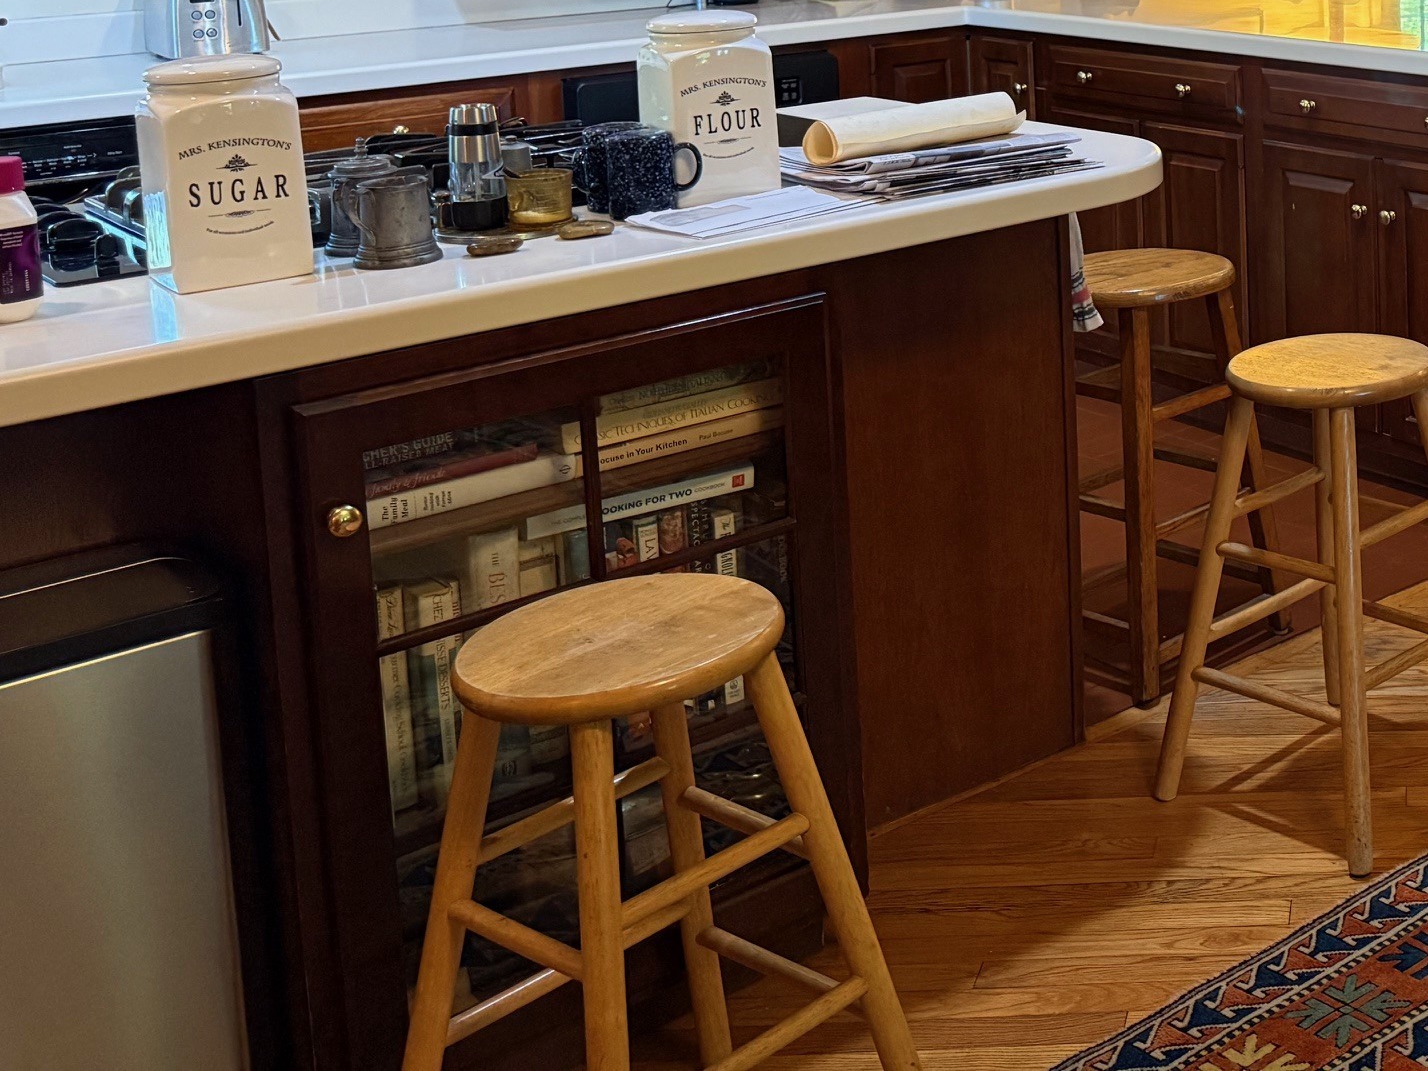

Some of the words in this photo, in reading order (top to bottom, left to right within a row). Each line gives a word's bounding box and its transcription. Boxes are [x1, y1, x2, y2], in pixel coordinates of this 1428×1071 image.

[680, 84, 702, 98] MRS.
[702, 77, 767, 89] KENSINGTON'S
[693, 107, 762, 136] FLOUR
[178, 145, 206, 161] MRS.
[208, 137, 292, 151] KENSINGTON'S
[188, 174, 290, 208] SUGAR
[614, 416, 673, 438] TECHNIQUES
[675, 412, 688, 424] OF
[690, 403, 724, 421] ITALIAN
[413, 431, 454, 449] GUIDE
[600, 453, 625, 465] ocuse
[635, 445, 654, 457] Your
[655, 438, 689, 452] Kitchen
[602, 500, 643, 516] OOKING
[645, 495, 666, 506] FOR
[668, 488, 692, 501] TWO
[488, 572, 507, 605] BES
[432, 594, 444, 621] CHEZ
[437, 665, 450, 710] DESSERTS
